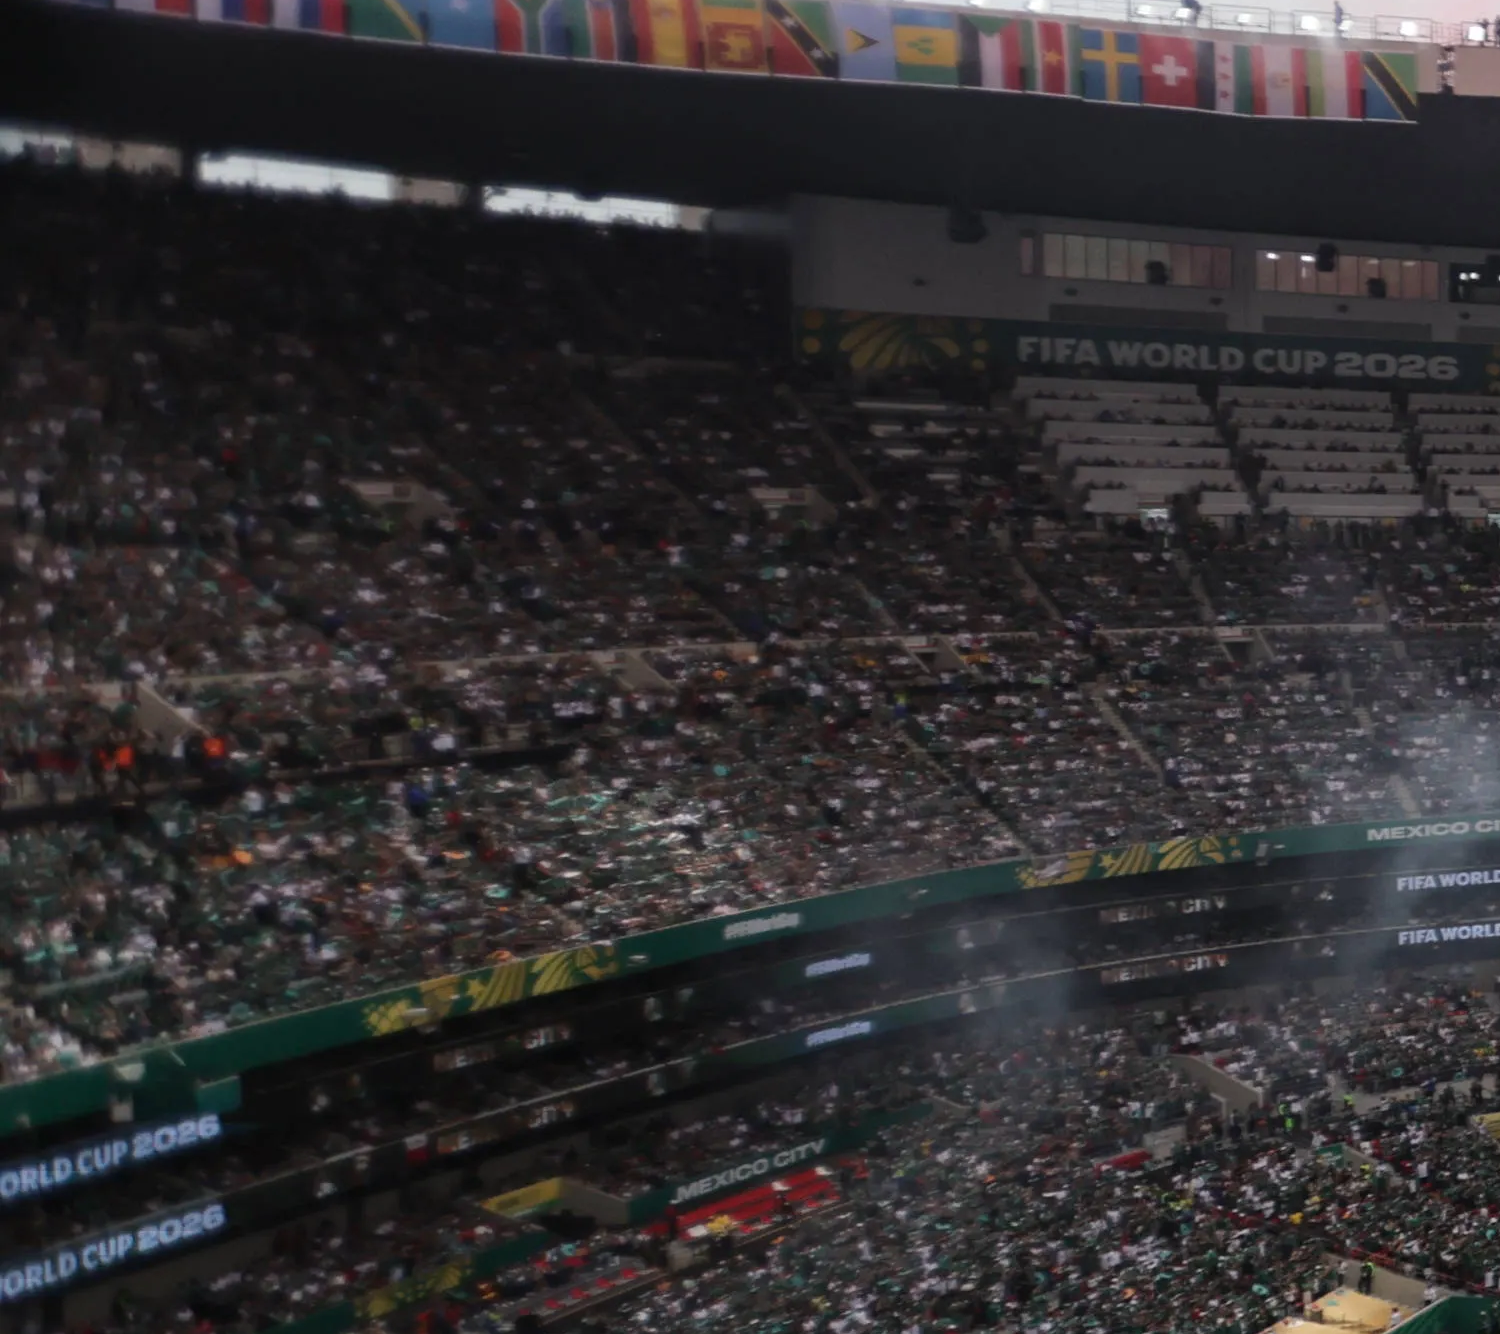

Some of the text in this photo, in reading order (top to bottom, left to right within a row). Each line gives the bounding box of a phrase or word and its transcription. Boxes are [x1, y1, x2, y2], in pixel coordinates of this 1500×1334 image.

[1016, 336, 1460, 380] FIFA WORLD CUP 2026
[1366, 820, 1470, 841] MEXICO
[1396, 874, 1436, 892] FIFA
[1398, 928, 1439, 947] FIFA
[0, 1113, 223, 1199] ORLD CUP 2026
[675, 1137, 827, 1202] MEXICO CITY
[82, 1232, 134, 1272] CUP
[137, 1203, 227, 1252] 2026
